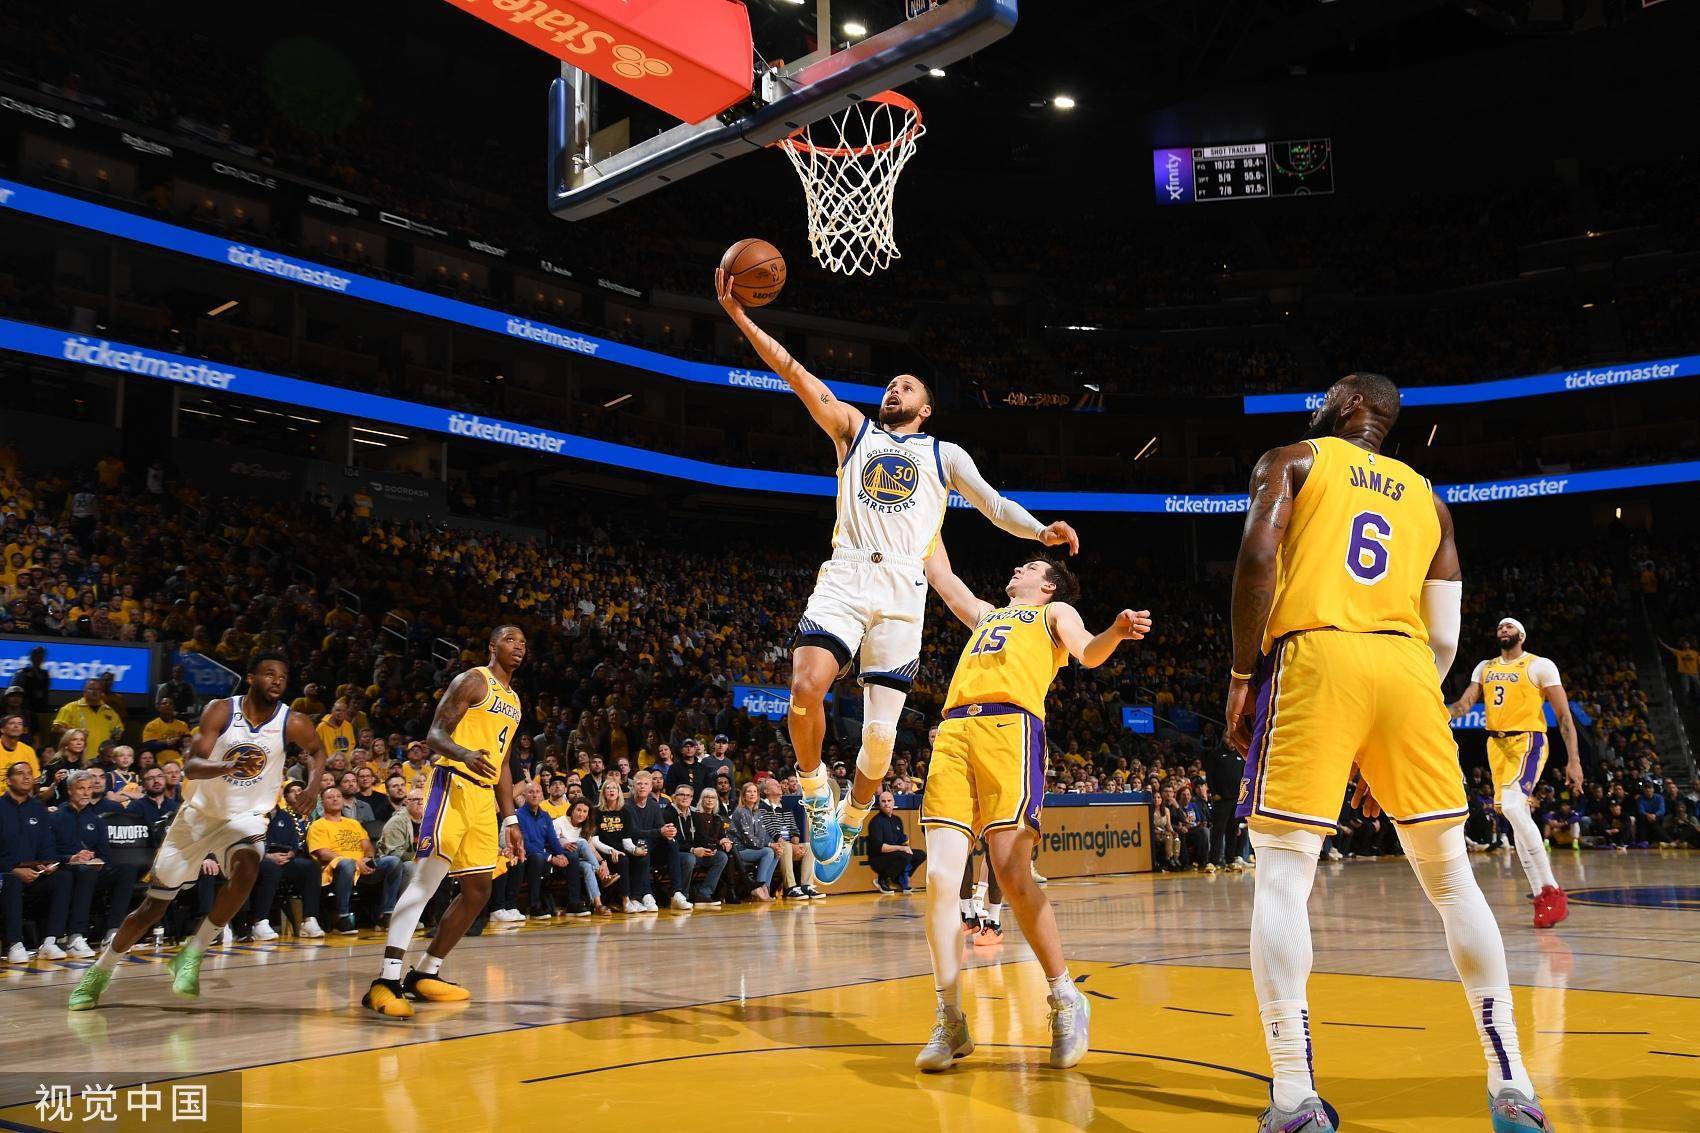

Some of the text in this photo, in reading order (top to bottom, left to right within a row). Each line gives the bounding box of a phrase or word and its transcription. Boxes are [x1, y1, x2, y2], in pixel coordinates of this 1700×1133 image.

[1210, 146, 1257, 155] SHOT TRACKER
[1166, 153, 1185, 200] xfinity
[228, 246, 351, 290] ticketmaster
[506, 319, 599, 354] ticketmaster
[64, 337, 235, 389] ticketmaster
[728, 369, 795, 392] ticketma
[1564, 363, 1680, 390] ticketmaster
[448, 413, 566, 453] ticketmaster
[866, 448, 900, 459] GOLDEN
[892, 465, 914, 481] 30
[1349, 465, 1406, 502] JAMES
[857, 489, 916, 514] WARRIORS
[1165, 495, 1252, 513] ticketmast
[1446, 479, 1569, 504] ticketmaster
[1344, 509, 1393, 586] 6
[970, 626, 1013, 655] 15
[1485, 670, 1520, 683] LAKERS
[743, 693, 791, 714] ticketm
[1493, 685, 1505, 706] 3
[487, 696, 520, 725] LAKERS
[498, 725, 509, 754] 4
[222, 775, 263, 787] ARRIORS
[107, 825, 149, 839] PLAYOFFS
[1041, 821, 1142, 858] reimagined
